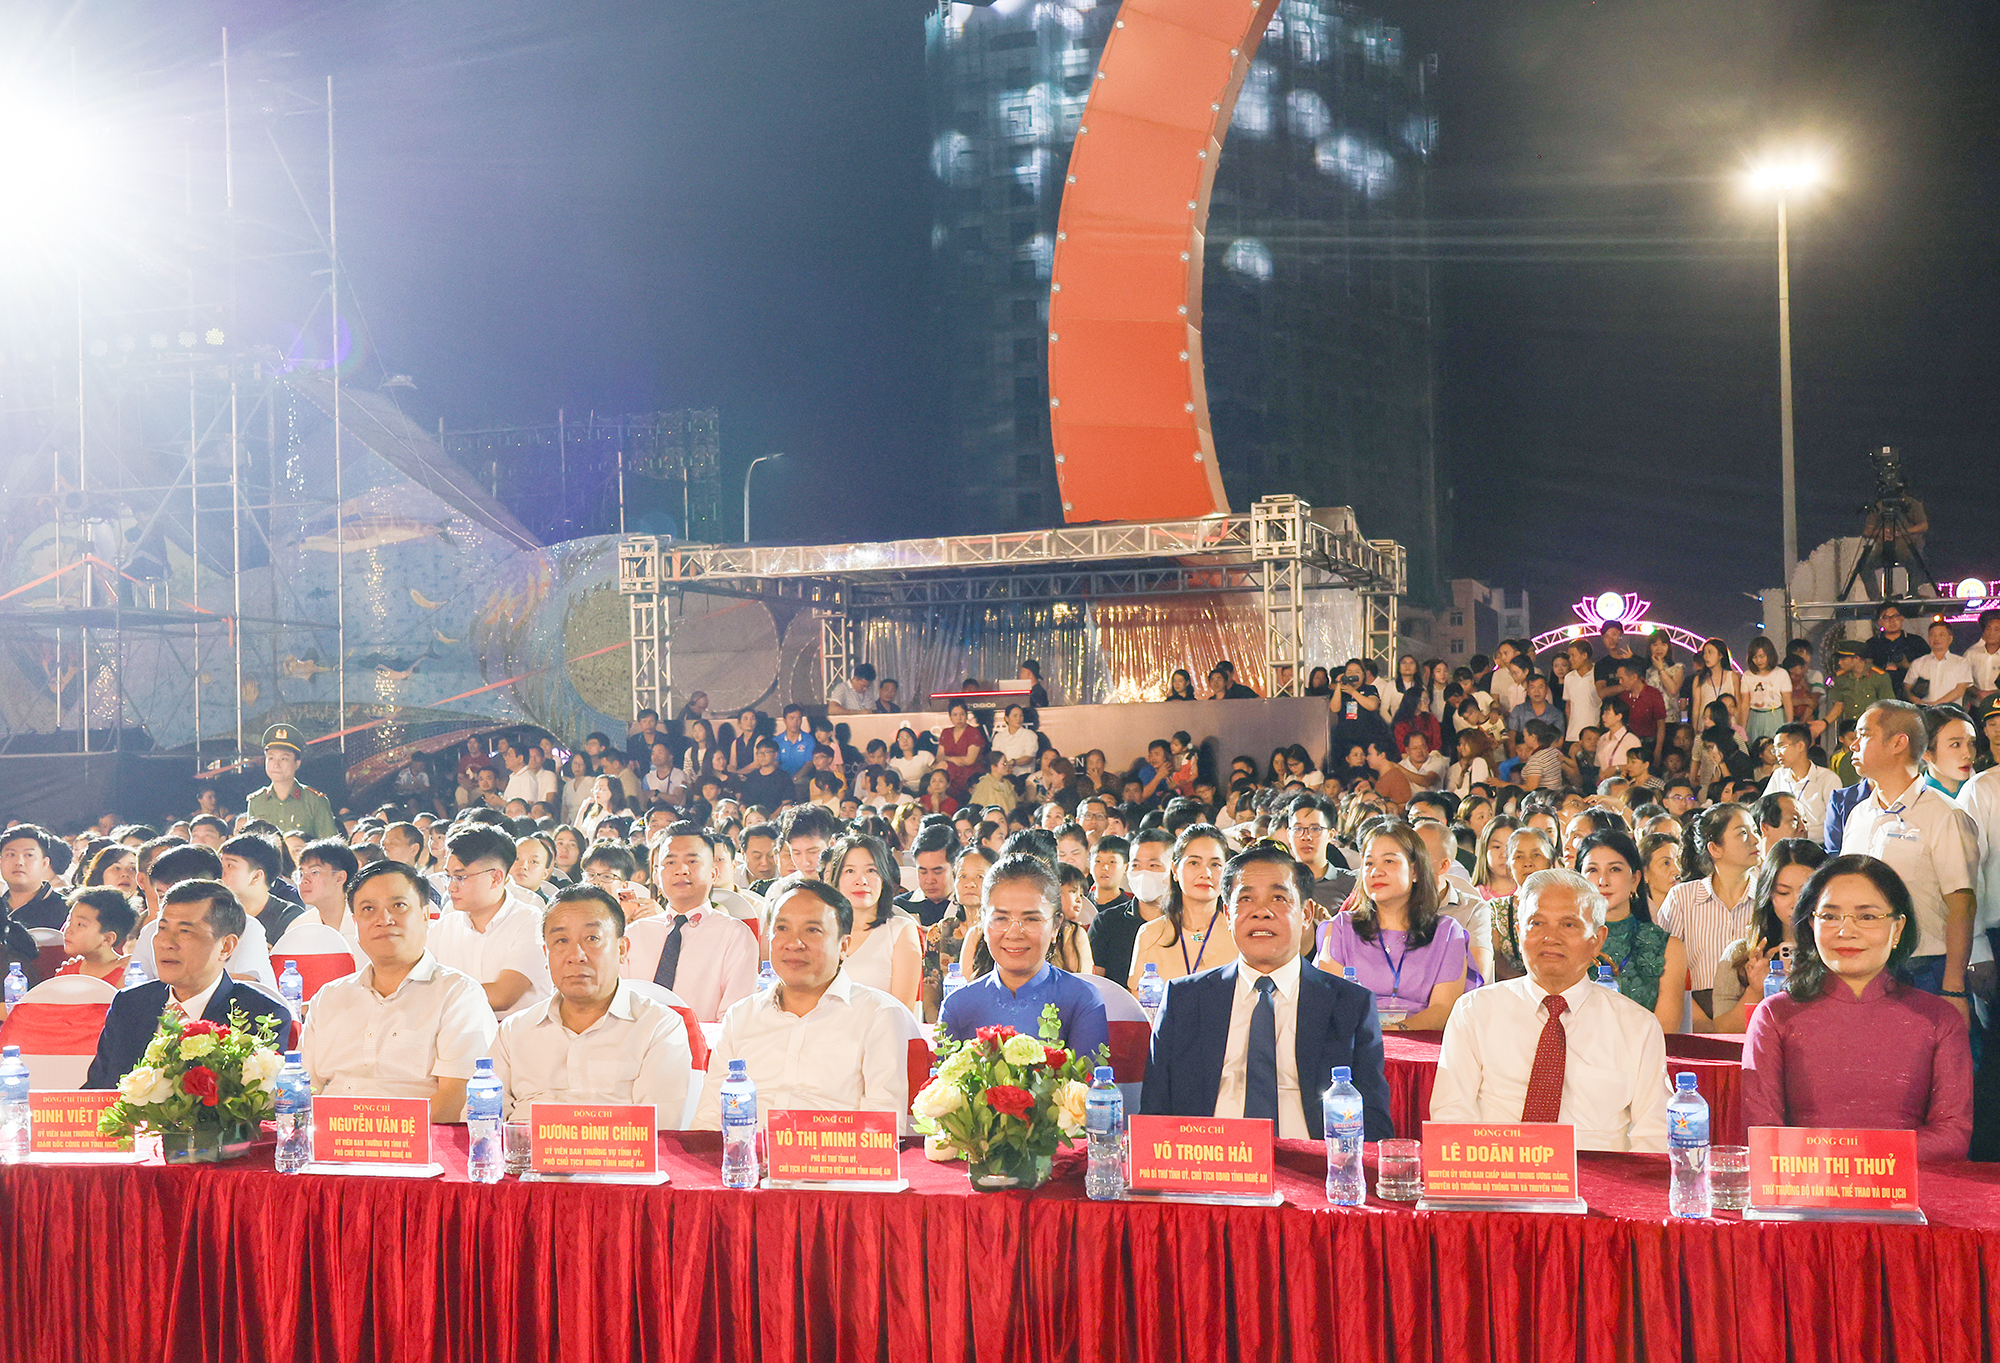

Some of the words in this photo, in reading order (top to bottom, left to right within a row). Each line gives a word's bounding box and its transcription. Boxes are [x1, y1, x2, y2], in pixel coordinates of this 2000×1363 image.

[377, 1103, 390, 1112] CHÍ
[33, 1109, 63, 1123] ĐINH
[67, 1106, 93, 1126] VIỆT
[598, 1110, 612, 1118] CHÍ
[813, 1115, 836, 1123] ĐỒNG
[838, 1115, 854, 1123] CHÍ
[329, 1113, 373, 1132] NGUYỄN
[376, 1116, 398, 1133] VĂN
[401, 1117, 416, 1137] ĐỆ
[1180, 1124, 1205, 1133] ĐỒNG
[1208, 1124, 1224, 1134] CHÍ
[539, 1124, 578, 1140] DƯƠNG
[581, 1122, 609, 1141] ĐÌNH
[612, 1122, 648, 1141] CHỈNH
[1474, 1128, 1501, 1137] ĐỒNG
[1503, 1128, 1521, 1137] CHÍ
[776, 1128, 793, 1146] VÕ
[796, 1131, 817, 1150] THỊ
[821, 1132, 856, 1147] MINH
[860, 1133, 892, 1148] SINH
[1806, 1136, 1836, 1145] ĐỒNG
[1839, 1136, 1858, 1145] CHÍ
[609, 1149, 616, 1157] VỤ
[1153, 1141, 1172, 1159] VÕ
[1176, 1144, 1224, 1164] TRỌNG
[1229, 1141, 1253, 1162] HẢI
[1441, 1142, 1461, 1162] LÊ
[1466, 1143, 1514, 1162] DOÃN
[1519, 1145, 1554, 1167] HỢP
[1770, 1156, 1819, 1177] TRỊNH
[1823, 1157, 1850, 1178] THỊ
[1854, 1153, 1896, 1175] THUỶ
[1260, 1174, 1267, 1183] AN
[1473, 1171, 1484, 1179] BAN
[1521, 1183, 1529, 1192] VÀ
[1801, 1185, 1810, 1198] BỘ
[1811, 1184, 1824, 1196] VĂN
[1855, 1187, 1870, 1198] THAO
[1872, 1186, 1880, 1198] VÀ
[1882, 1188, 1890, 1199] DU
[1892, 1188, 1906, 1201] LỊCH
